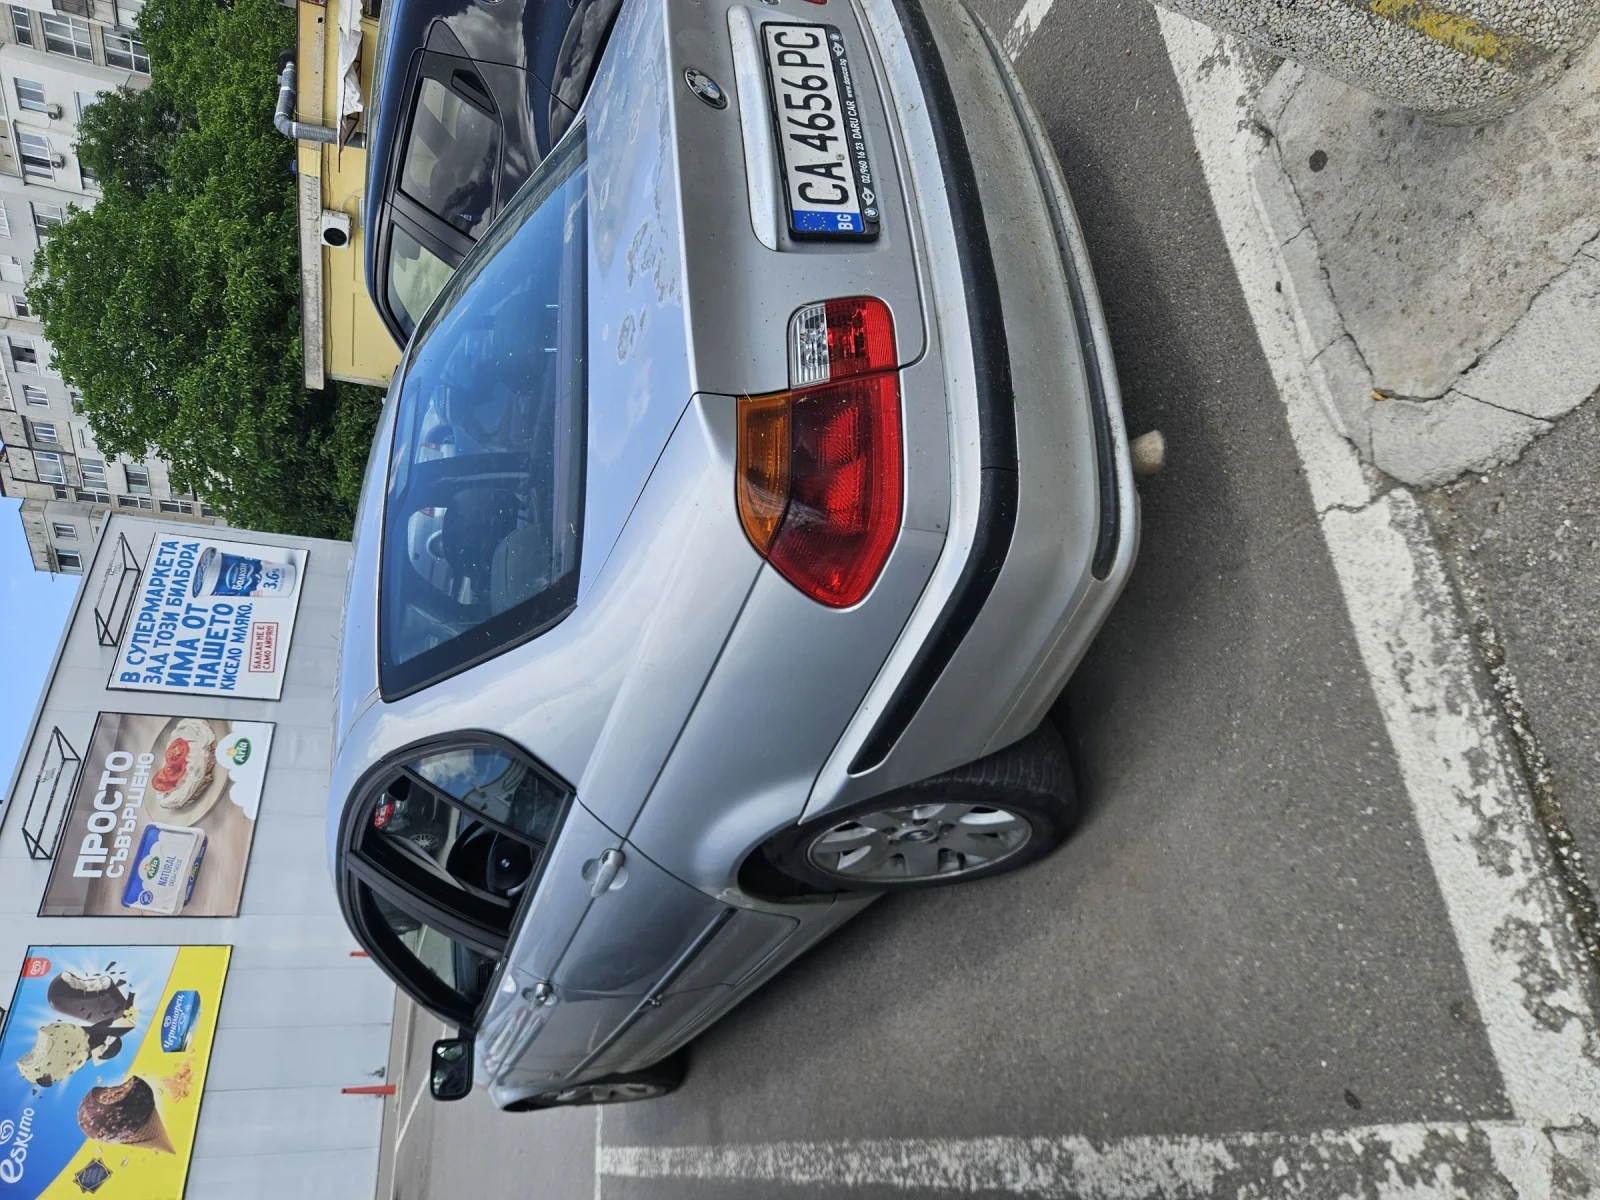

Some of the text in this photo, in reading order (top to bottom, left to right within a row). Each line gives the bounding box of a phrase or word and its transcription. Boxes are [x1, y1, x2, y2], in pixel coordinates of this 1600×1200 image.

[840, 59, 854, 98] www.darucar.bg
[846, 101, 856, 116] CAR
[849, 117, 862, 139] DARU
[855, 142, 864, 150] 23
[859, 161, 871, 183] 02/960
[838, 213, 853, 230] BG
[120, 541, 179, 682] В СУПЕРМАРКЕТА
[143, 543, 200, 684] ЗАД ТОЗИ БИЛБОРД
[182, 603, 207, 629] ОТ
[194, 603, 233, 687] НАШЕТО
[221, 603, 253, 690] КИСЕЛО МЛЯКО.
[253, 642, 263, 669] БАЛКАН
[166, 639, 200, 687] ИМА
[263, 651, 271, 669] САМО
[235, 742, 248, 762] Arla
[73, 751, 134, 878] ПРОСТО
[106, 752, 154, 878] СЪВЪРШЕНО
[148, 860, 158, 876] Arla
[158, 856, 176, 886] NATURAL
[163, 995, 184, 1048] Черноморец
